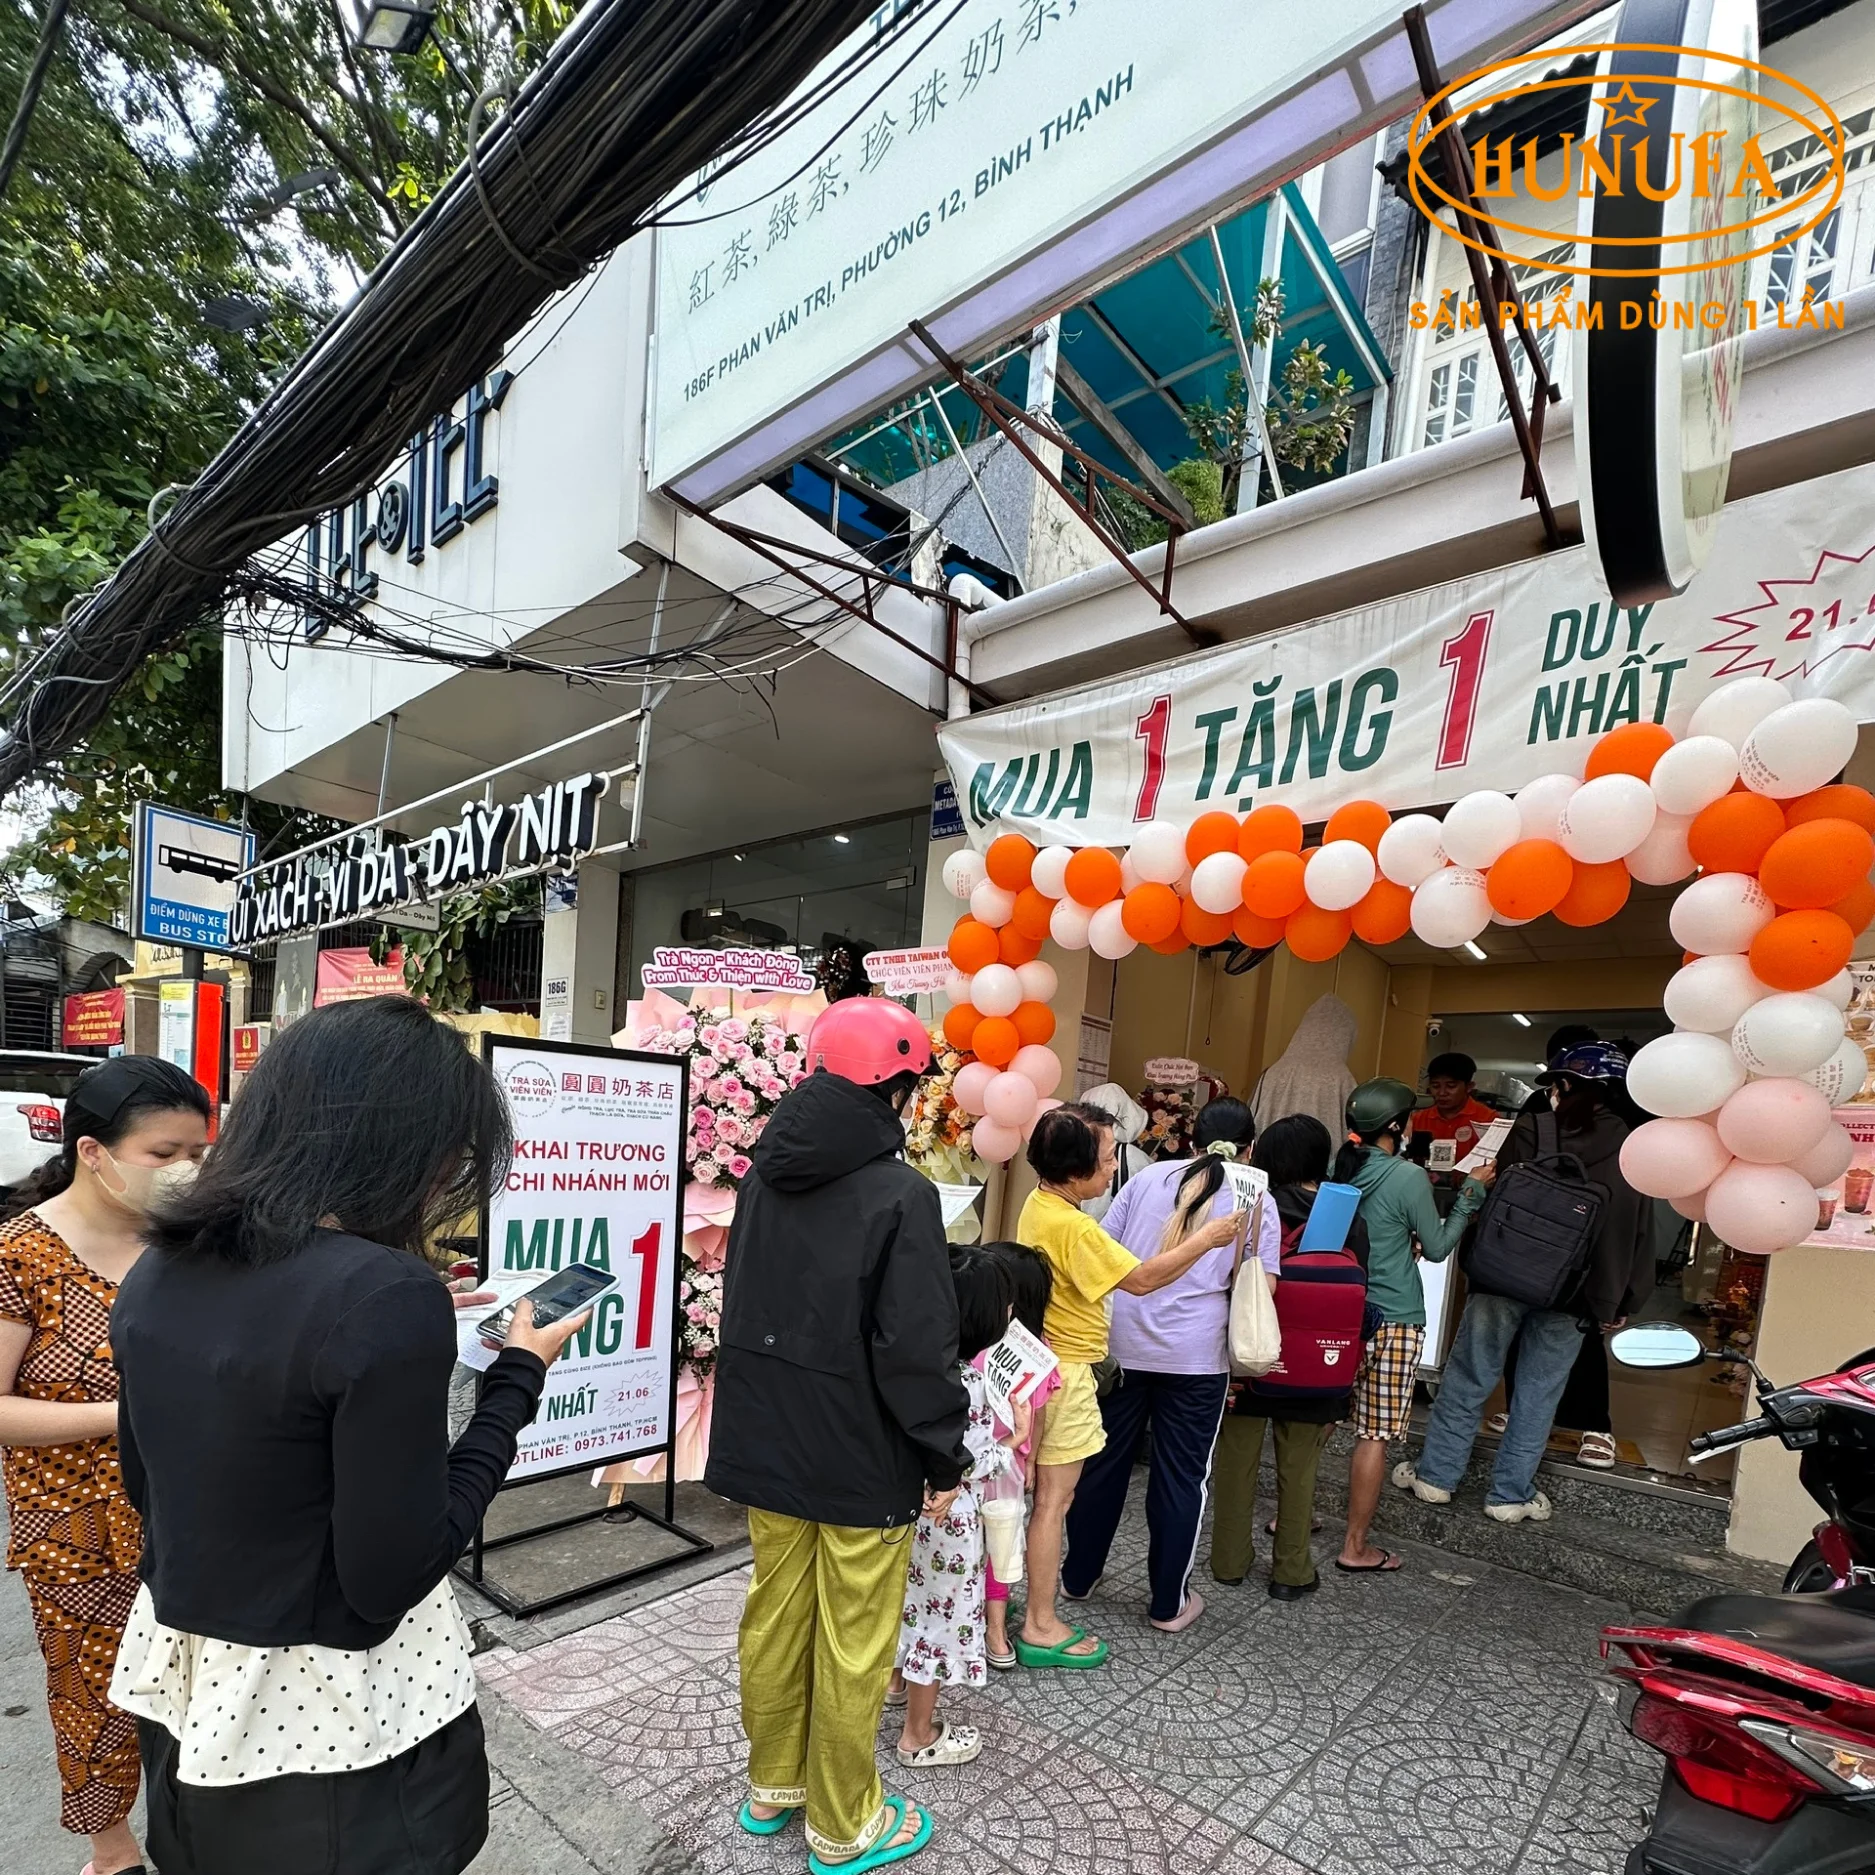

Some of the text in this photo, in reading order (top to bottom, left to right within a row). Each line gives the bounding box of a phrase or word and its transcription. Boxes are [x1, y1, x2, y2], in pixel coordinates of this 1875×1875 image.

[683, 63, 1134, 402] 186F PHAN VĂN TRỊ, PHƯỜNG 12, BÌNH THẠNH
[1785, 594, 1875, 642] 21.
[1541, 599, 1656, 673] DUY
[1526, 643, 1688, 745] NHẤT
[968, 609, 1495, 829] MUA 1 TẶNG 1
[253, 865, 311, 937] XÁCH
[329, 834, 353, 914] VÍ
[358, 843, 397, 907] DA
[427, 800, 504, 887] DÂY
[518, 772, 593, 866] NỊT
[149, 902, 176, 919] ĐIỂM
[178, 906, 206, 925] DỪNG
[207, 914, 221, 927] XE
[159, 922, 227, 945] BUS STO
[656, 951, 679, 967] Trà
[680, 951, 714, 969] Ngon
[725, 951, 763, 969] Khách
[765, 954, 800, 974] Đông
[644, 968, 678, 985] From
[754, 971, 780, 986] with
[781, 974, 812, 990] Love
[511, 1076, 551, 1087] TRÀ SỮA
[561, 1072, 674, 1100] 圓圓奶茶店
[514, 1139, 665, 1162] KHAI TRƯƠNG
[505, 1168, 670, 1191] CHI NHÁNH MỚI
[503, 1217, 664, 1352] MUA 1
[991, 1342, 1023, 1376] MUA
[546, 1382, 598, 1423] NHẤT
[617, 1386, 649, 1402] 21.06
[512, 1423, 658, 1466] OTLINE: 0973.741.768
[771, 1791, 807, 1801] CAPYBA
